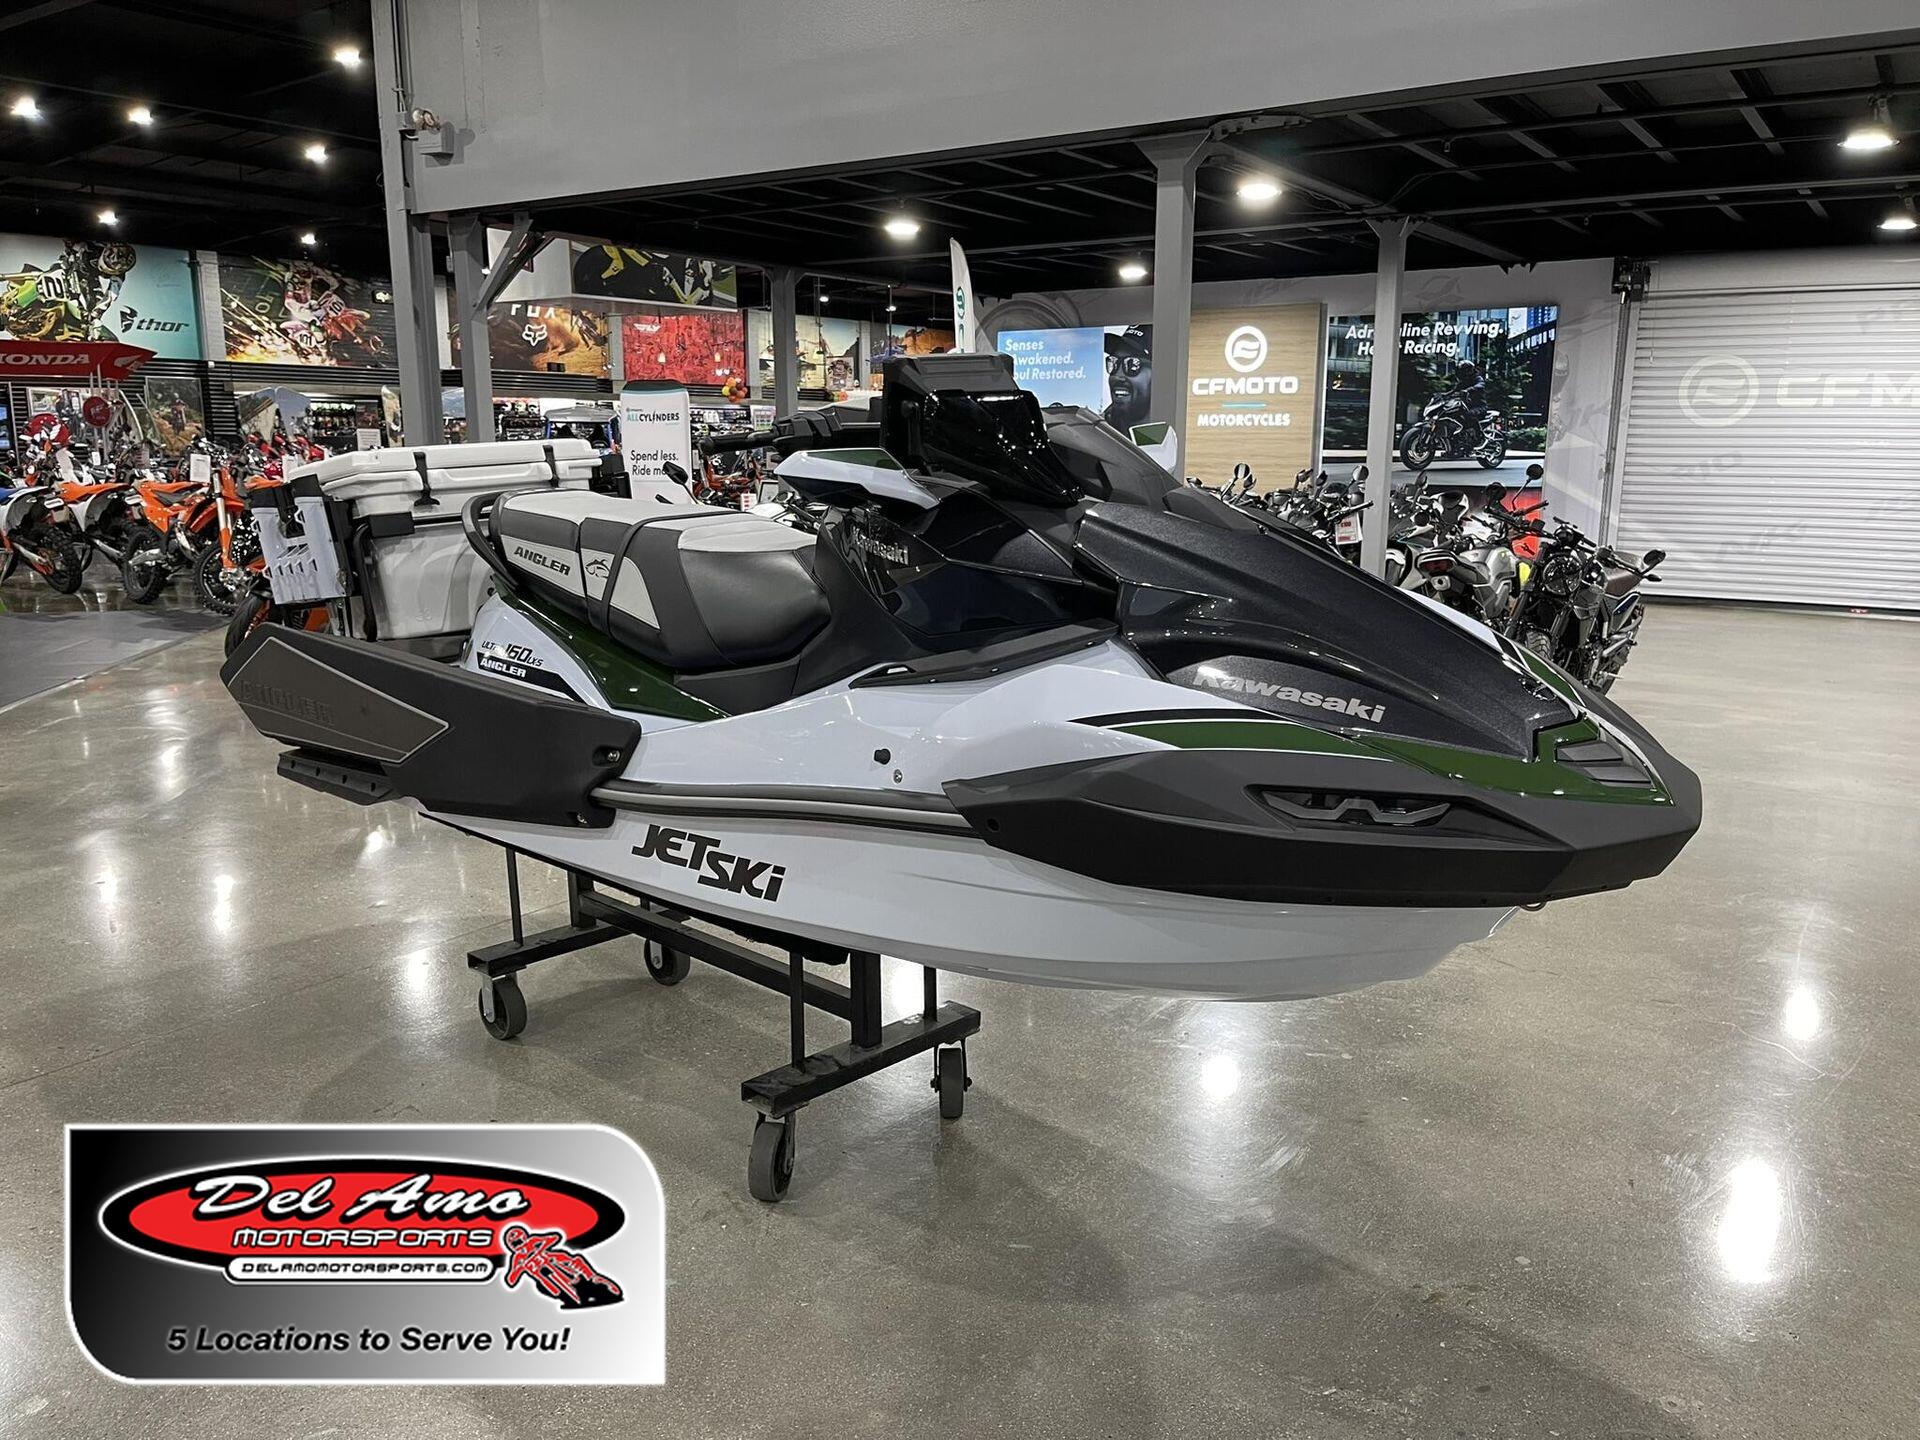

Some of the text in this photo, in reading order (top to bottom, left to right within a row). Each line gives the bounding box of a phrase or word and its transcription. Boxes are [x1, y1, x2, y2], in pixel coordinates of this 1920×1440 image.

[136, 318, 190, 333] thor
[1433, 320, 1504, 339] Revving.
[1005, 339, 1045, 352] Senses
[1404, 340, 1461, 357] Racing.
[1013, 365, 1087, 381] oul Restored.
[1192, 376, 1299, 396] CFMOTO
[1197, 412, 1291, 427] MOTORCYCLES
[630, 450, 679, 463] Spend less.
[632, 465, 651, 475] Ride
[514, 546, 571, 576] ANGLER
[480, 658, 527, 678] ANGLER
[1193, 665, 1386, 723] Kawasaki
